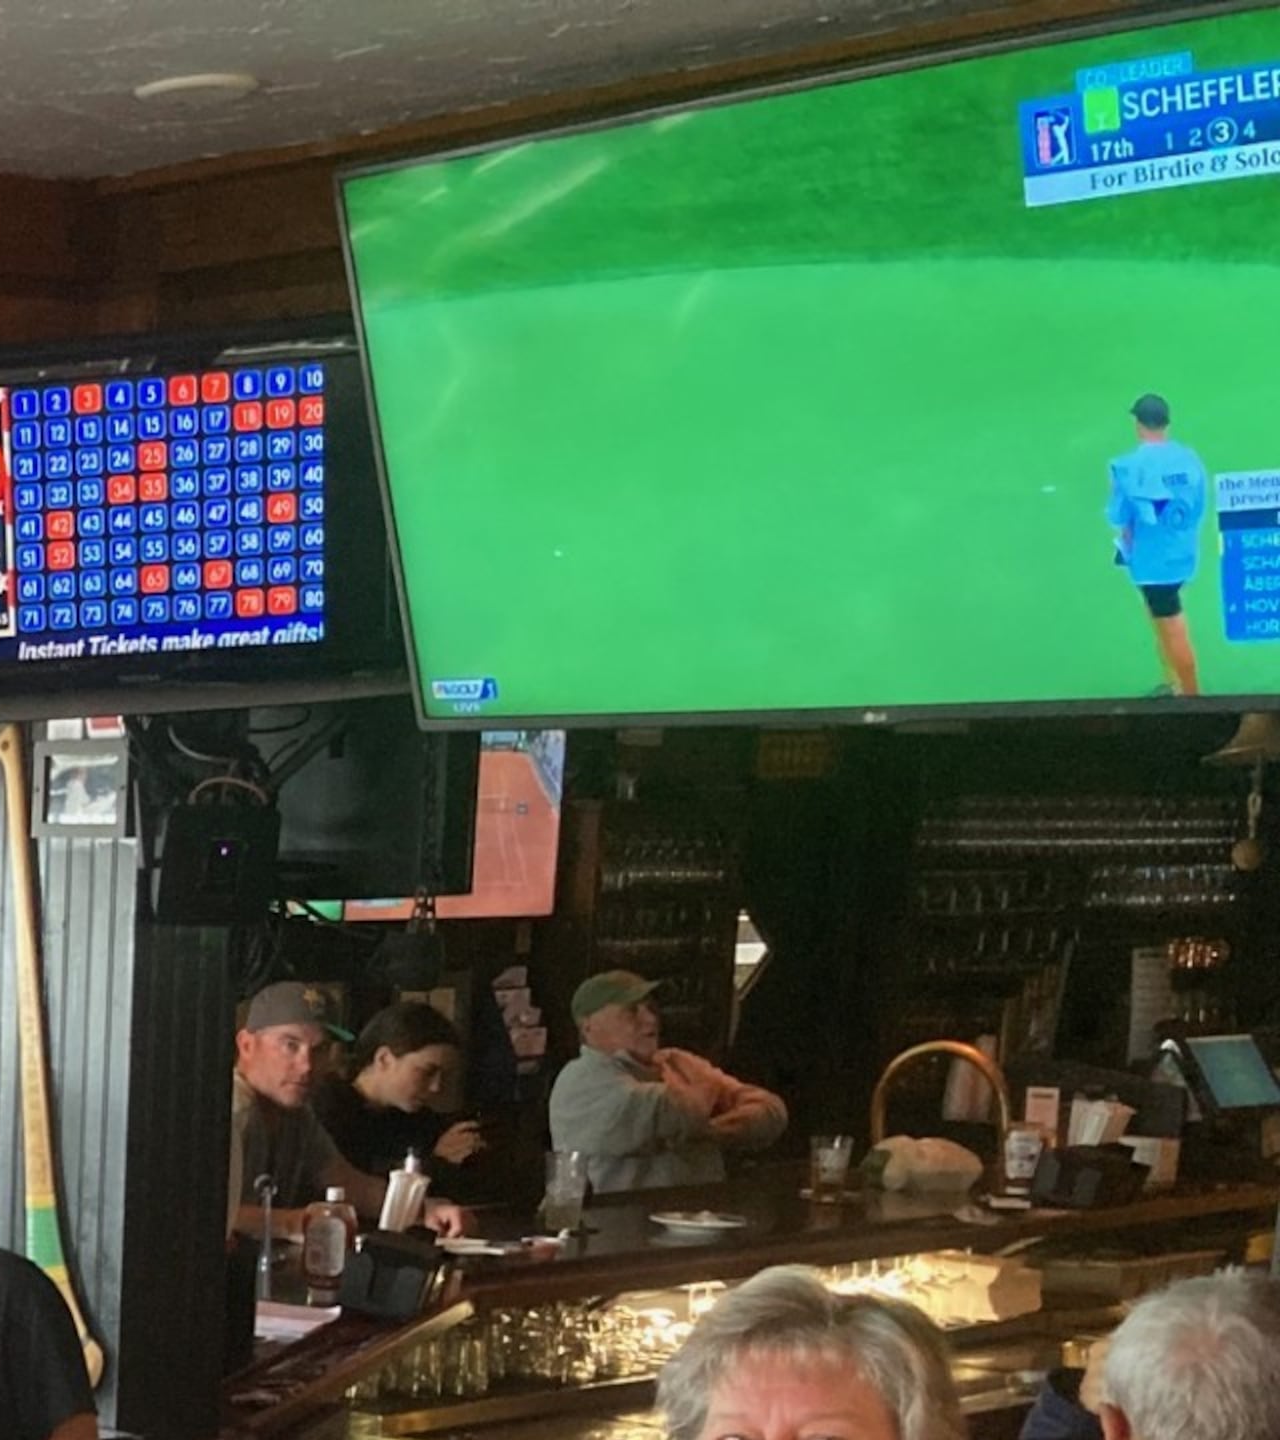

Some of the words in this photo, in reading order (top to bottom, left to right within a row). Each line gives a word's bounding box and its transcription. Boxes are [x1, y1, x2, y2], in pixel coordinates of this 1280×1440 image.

[1090, 137, 1134, 162] 17th
[1165, 131, 1174, 150] 1
[1189, 127, 1203, 148] 2
[1213, 121, 1230, 143] 3
[1242, 119, 1256, 139] 4
[1090, 170, 1127, 190] For
[1133, 158, 1205, 185] Birdie
[21, 397, 28, 413] 1
[51, 393, 61, 411] 2
[84, 390, 93, 409] 3
[114, 388, 125, 404] 4
[146, 385, 157, 403] 5
[178, 383, 189, 399] 6
[211, 379, 220, 396] 7
[243, 375, 253, 394] 8
[275, 372, 286, 390] 9
[306, 369, 324, 387] 10
[20, 427, 32, 444] 11
[51, 424, 66, 441] 12
[83, 421, 97, 439] 13
[114, 419, 129, 436] 14
[145, 416, 160, 433] 15
[177, 414, 193, 431] 16
[209, 410, 224, 427] 17
[243, 408, 257, 425] 18
[275, 405, 291, 421] 19
[305, 402, 323, 419] 20
[19, 458, 34, 475] 21
[50, 455, 67, 473] 22
[81, 453, 98, 470] 23
[112, 451, 130, 467] 24
[144, 448, 162, 465] 25
[175, 446, 194, 462] 26
[208, 442, 225, 459] 27
[240, 439, 258, 457] 28
[272, 437, 291, 454] 29
[305, 433, 324, 451] 30
[21, 489, 35, 506] 31
[51, 486, 68, 503] 32
[82, 484, 99, 501] 33
[114, 482, 131, 498] 34
[145, 479, 163, 496] 35
[177, 477, 195, 493] 36
[208, 473, 226, 491] 37
[241, 471, 258, 489] 38
[272, 468, 291, 486] 39
[304, 465, 324, 483] 40
[21, 520, 36, 535] 41
[52, 517, 69, 533] 42
[83, 515, 100, 531] 43
[114, 513, 131, 528] 44
[145, 510, 164, 526] 45
[176, 508, 195, 524] 46
[208, 504, 226, 521] 47
[240, 502, 258, 519] 48
[273, 500, 291, 515] 49
[305, 496, 324, 515] 50
[23, 550, 37, 567] 51
[54, 547, 70, 564] 52
[84, 545, 101, 562] 53
[115, 543, 132, 560] 54
[146, 540, 164, 557] 55
[177, 538, 196, 555] 56
[209, 535, 226, 553] 57
[241, 533, 259, 550] 58
[273, 531, 292, 548] 59
[305, 528, 324, 546] 60
[23, 580, 37, 597] 61
[52, 577, 71, 595] 62
[84, 575, 101, 592] 63
[115, 574, 133, 590] 64
[147, 572, 163, 587] 65
[177, 569, 196, 585] 66
[209, 566, 227, 583] 67
[241, 564, 259, 580] 68
[272, 562, 292, 578] 69
[306, 559, 324, 576] 70
[25, 610, 39, 625] 71
[55, 607, 71, 623] 72
[86, 605, 102, 621] 73
[117, 604, 133, 619] 74
[148, 601, 164, 617] 75
[179, 599, 196, 615] 76
[210, 596, 228, 612] 77
[243, 595, 259, 610] 78
[275, 592, 291, 607] 79
[305, 590, 324, 607] 80
[18, 638, 86, 661] Instant
[87, 632, 158, 656] Tickets
[161, 628, 215, 652] make
